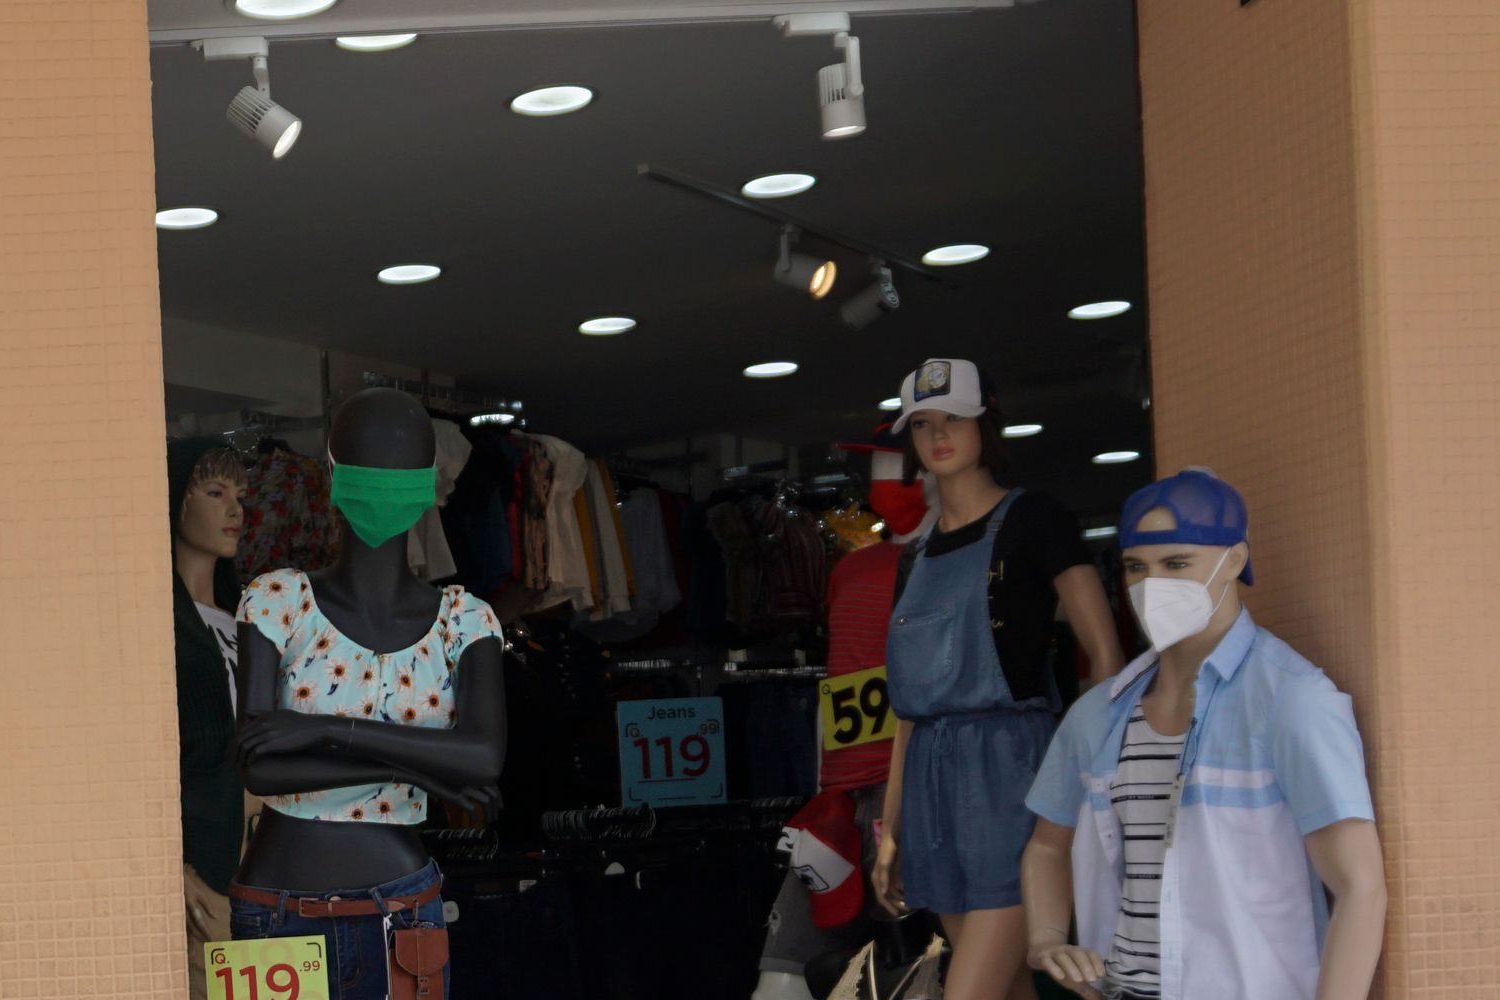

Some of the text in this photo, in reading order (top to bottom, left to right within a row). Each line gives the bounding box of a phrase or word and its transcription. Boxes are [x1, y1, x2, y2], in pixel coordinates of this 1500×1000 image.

[648, 706, 696, 720] Jeans
[831, 677, 890, 744] 59
[633, 735, 711, 780] 119
